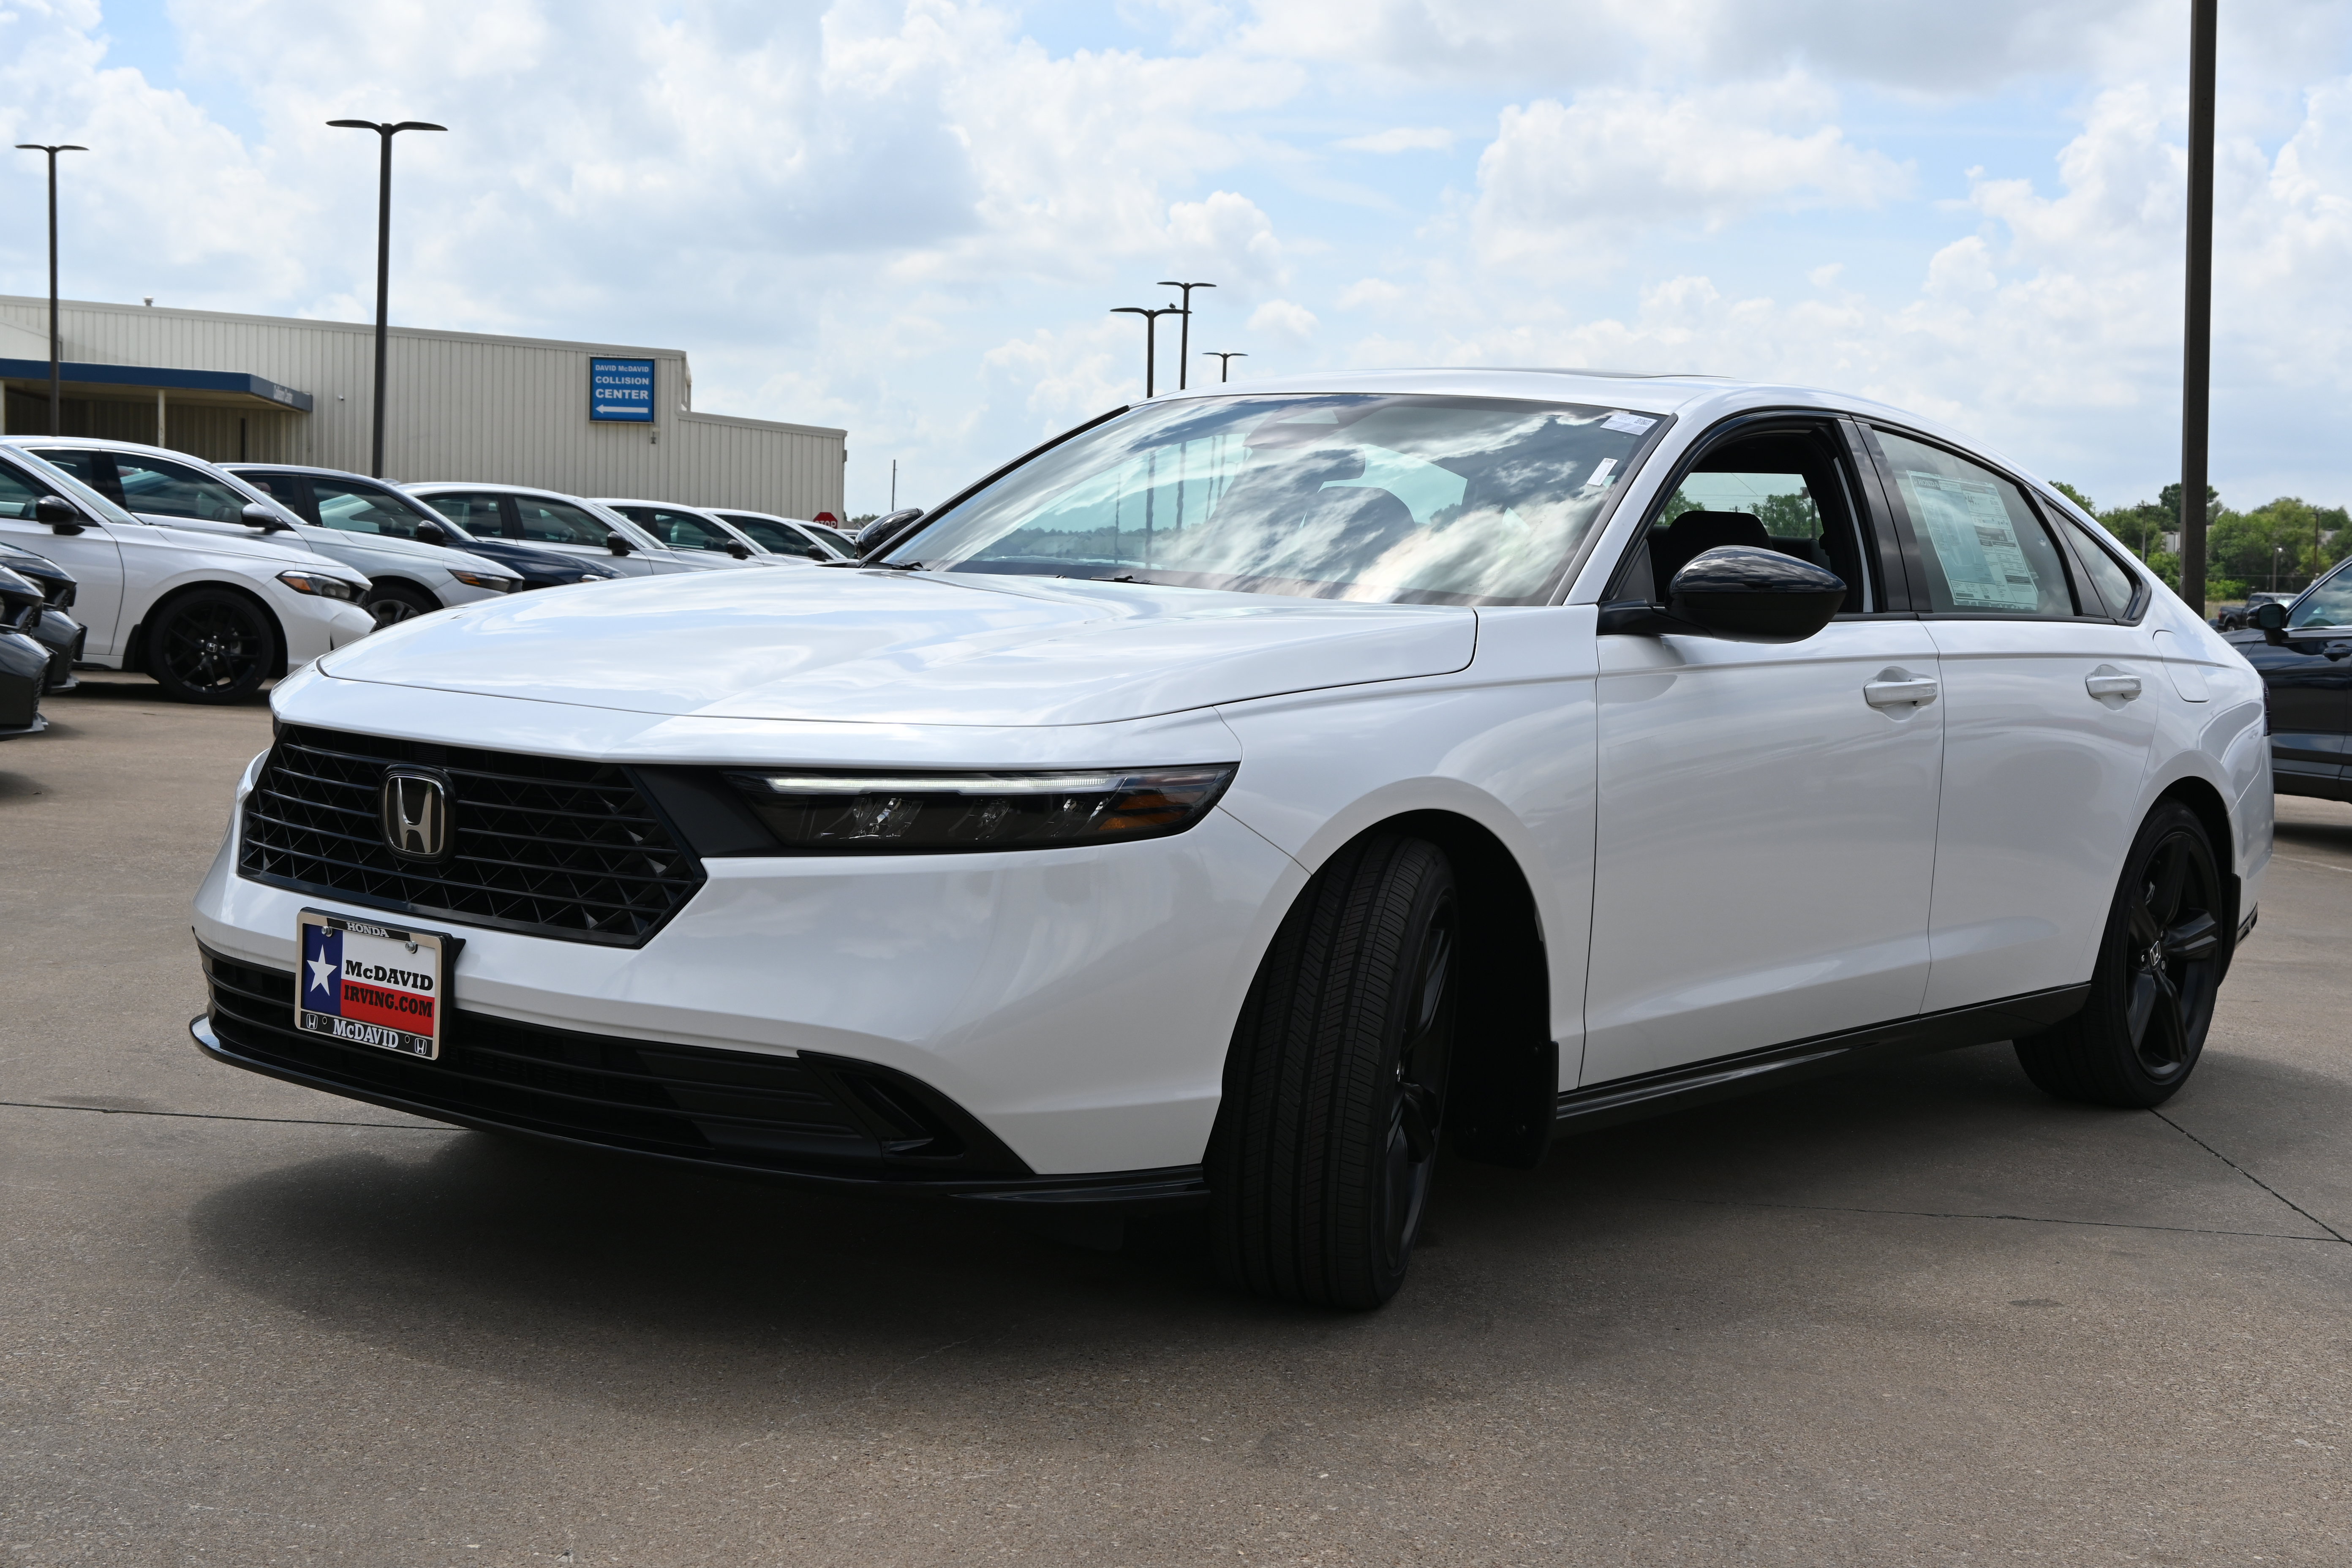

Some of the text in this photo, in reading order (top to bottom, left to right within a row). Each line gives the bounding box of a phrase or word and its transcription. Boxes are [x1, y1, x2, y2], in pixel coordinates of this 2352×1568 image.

[595, 376, 649, 385] COLLISION
[595, 389, 649, 399] CENTER
[1918, 479, 1940, 487] HONDA
[346, 922, 389, 938] HONDA
[345, 959, 434, 991] McDAVID
[344, 984, 433, 1018] IRVING.COM
[332, 1018, 399, 1048] McDAVID
